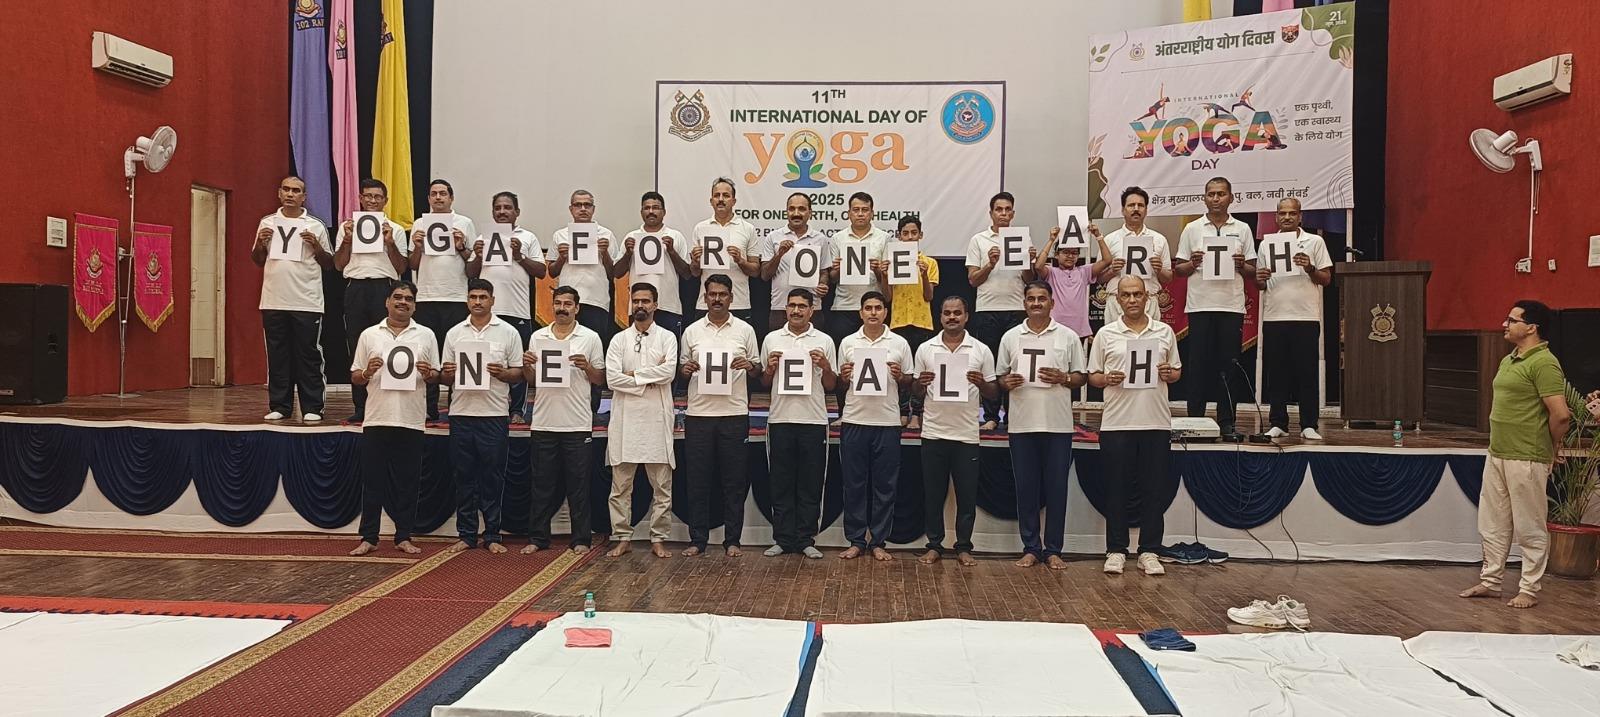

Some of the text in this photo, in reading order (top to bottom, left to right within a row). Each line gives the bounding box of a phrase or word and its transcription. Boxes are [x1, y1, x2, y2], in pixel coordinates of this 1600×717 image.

[1329, 11, 1342, 21] 21
[1155, 30, 1275, 56] अंतरराष्ट्रीय योग दिवस
[1174, 93, 1239, 103] INTERNATIONAL
[730, 109, 928, 124] INTERNATIONAL DAY OF
[1128, 111, 1287, 159] YOGA
[1294, 129, 1342, 141] के लिये योग
[1191, 159, 1219, 170] DAY
[810, 193, 844, 205] 2025
[1266, 187, 1284, 199] नवी
[734, 209, 760, 220] FOR
[762, 209, 788, 220] ONE
